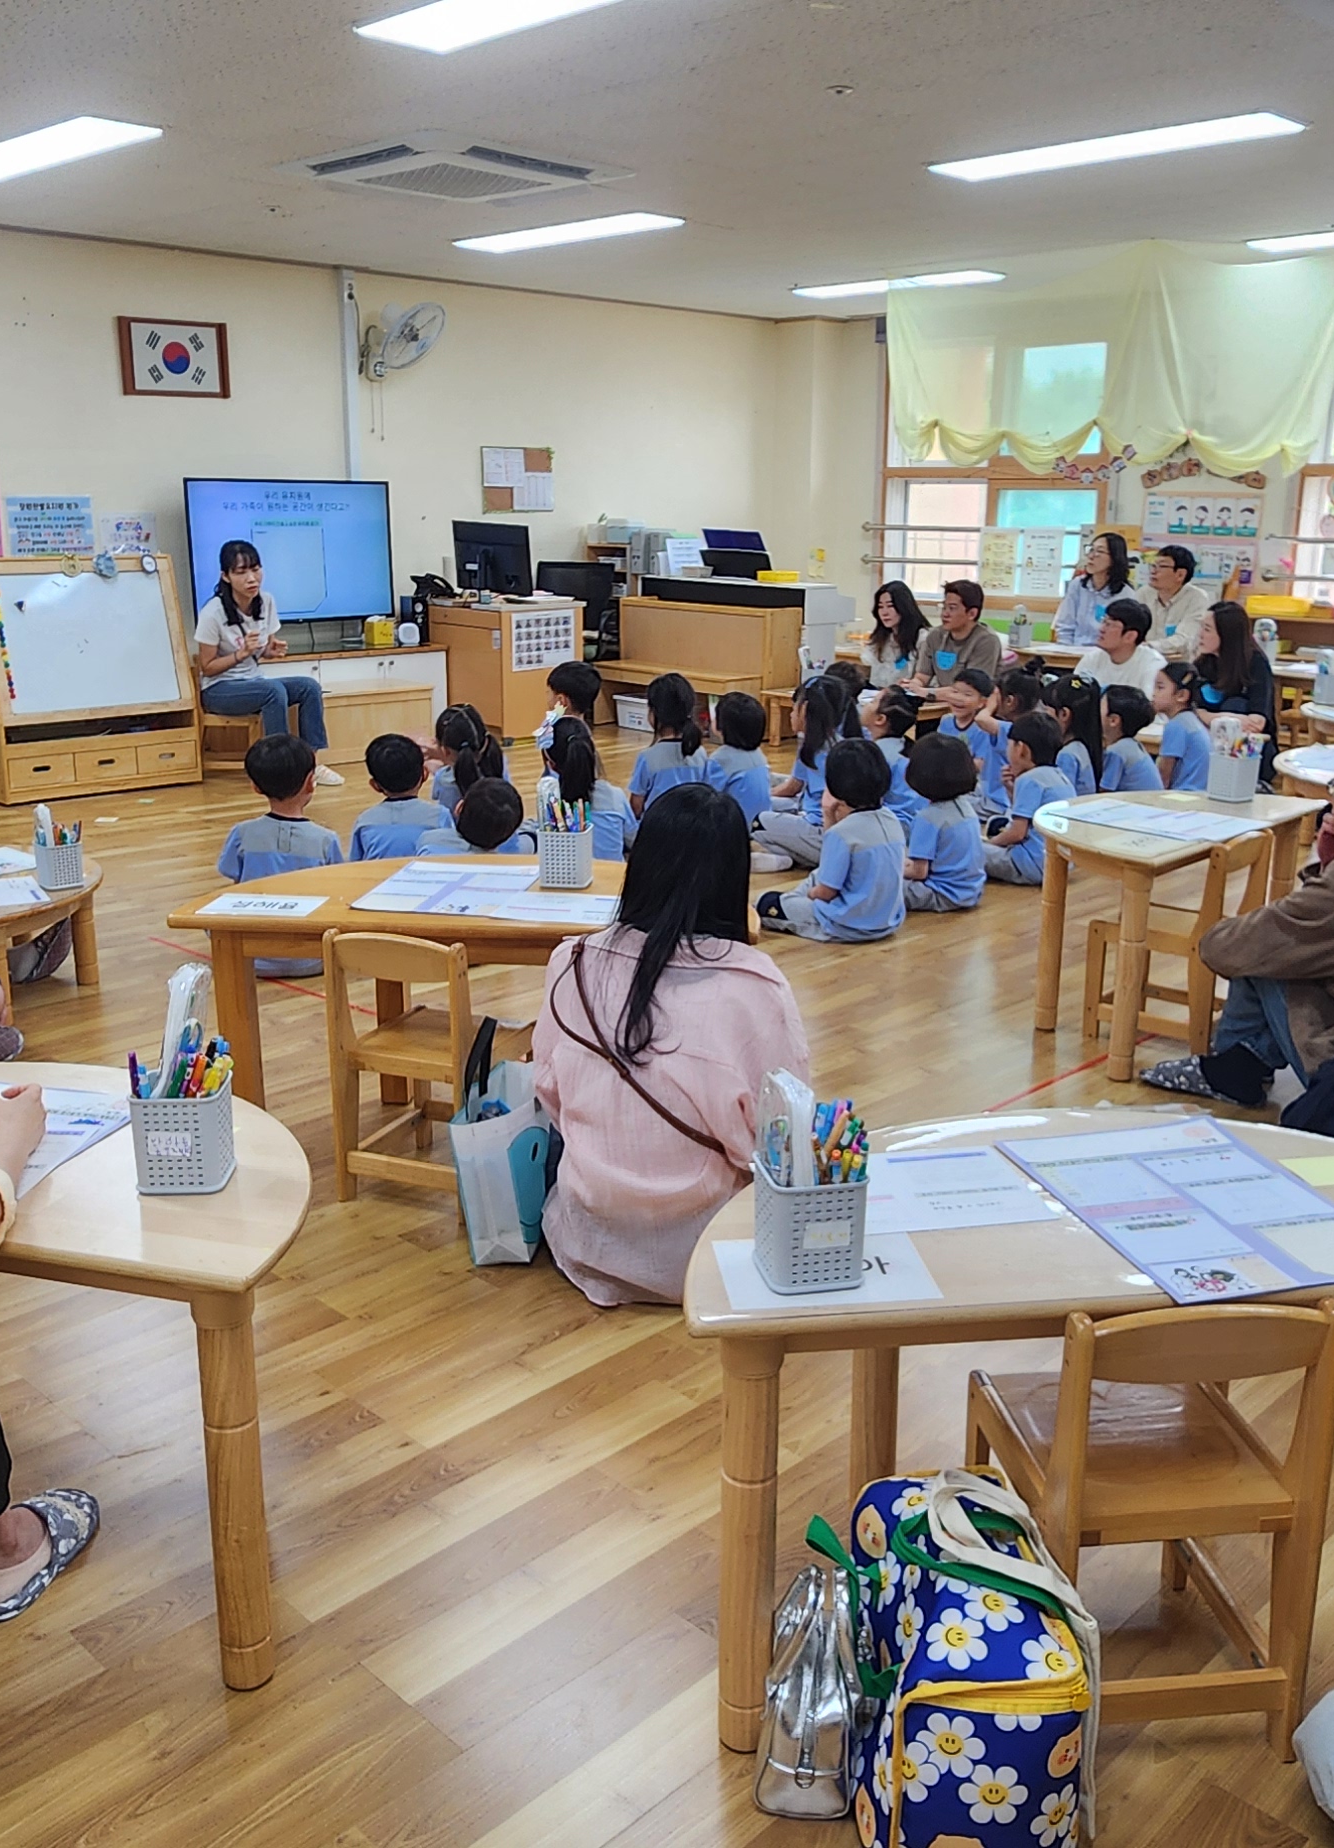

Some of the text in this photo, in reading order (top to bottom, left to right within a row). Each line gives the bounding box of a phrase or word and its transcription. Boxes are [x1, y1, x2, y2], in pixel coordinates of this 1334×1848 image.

[264, 491, 311, 501] 우리 유치원에
[222, 501, 238, 511] 우리
[241, 501, 264, 511] 가족이
[267, 502, 289, 511] 원하는
[292, 502, 314, 512] 공간이
